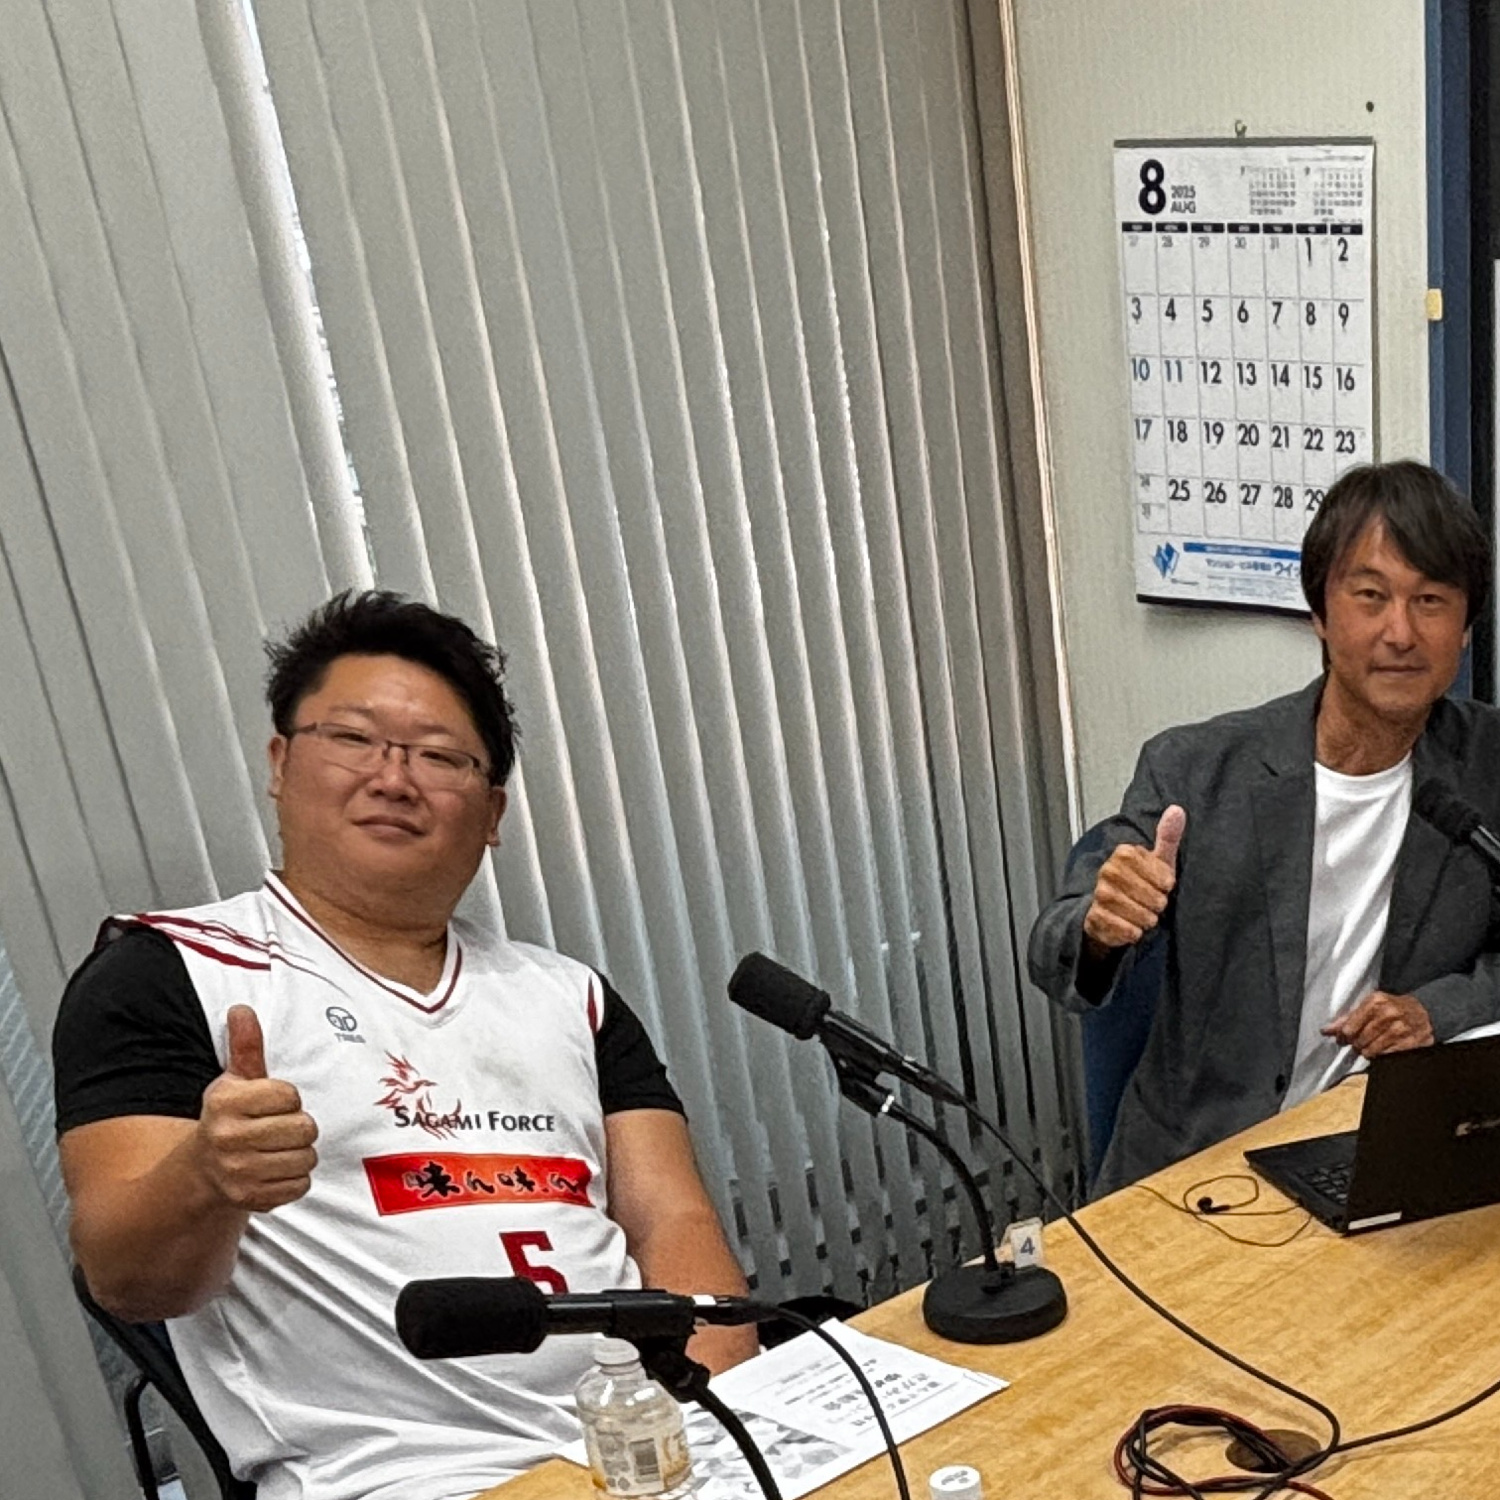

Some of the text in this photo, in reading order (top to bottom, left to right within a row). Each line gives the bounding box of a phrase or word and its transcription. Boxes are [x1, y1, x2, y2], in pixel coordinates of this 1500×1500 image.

[1138, 159, 1166, 215] 8
[1171, 185, 1196, 199] 2025
[1171, 201, 1196, 214] AUG
[1305, 237, 1312, 262] 1
[1338, 237, 1349, 262] 2
[1131, 297, 1349, 328] 3 4 5 6 7 8 9
[1132, 358, 1355, 391] 10 11 12 13 14 15 16
[1134, 419, 1355, 454] 17 18 19 20 21 22 23
[1168, 478, 1190, 501] 25
[1204, 481, 1227, 504] 26
[1240, 484, 1261, 506] 27
[1274, 486, 1293, 509] 28
[1305, 489, 1325, 511] 29
[394, 1105, 555, 1132] SAGAMI FORCE
[1020, 1236, 1036, 1255] 4
